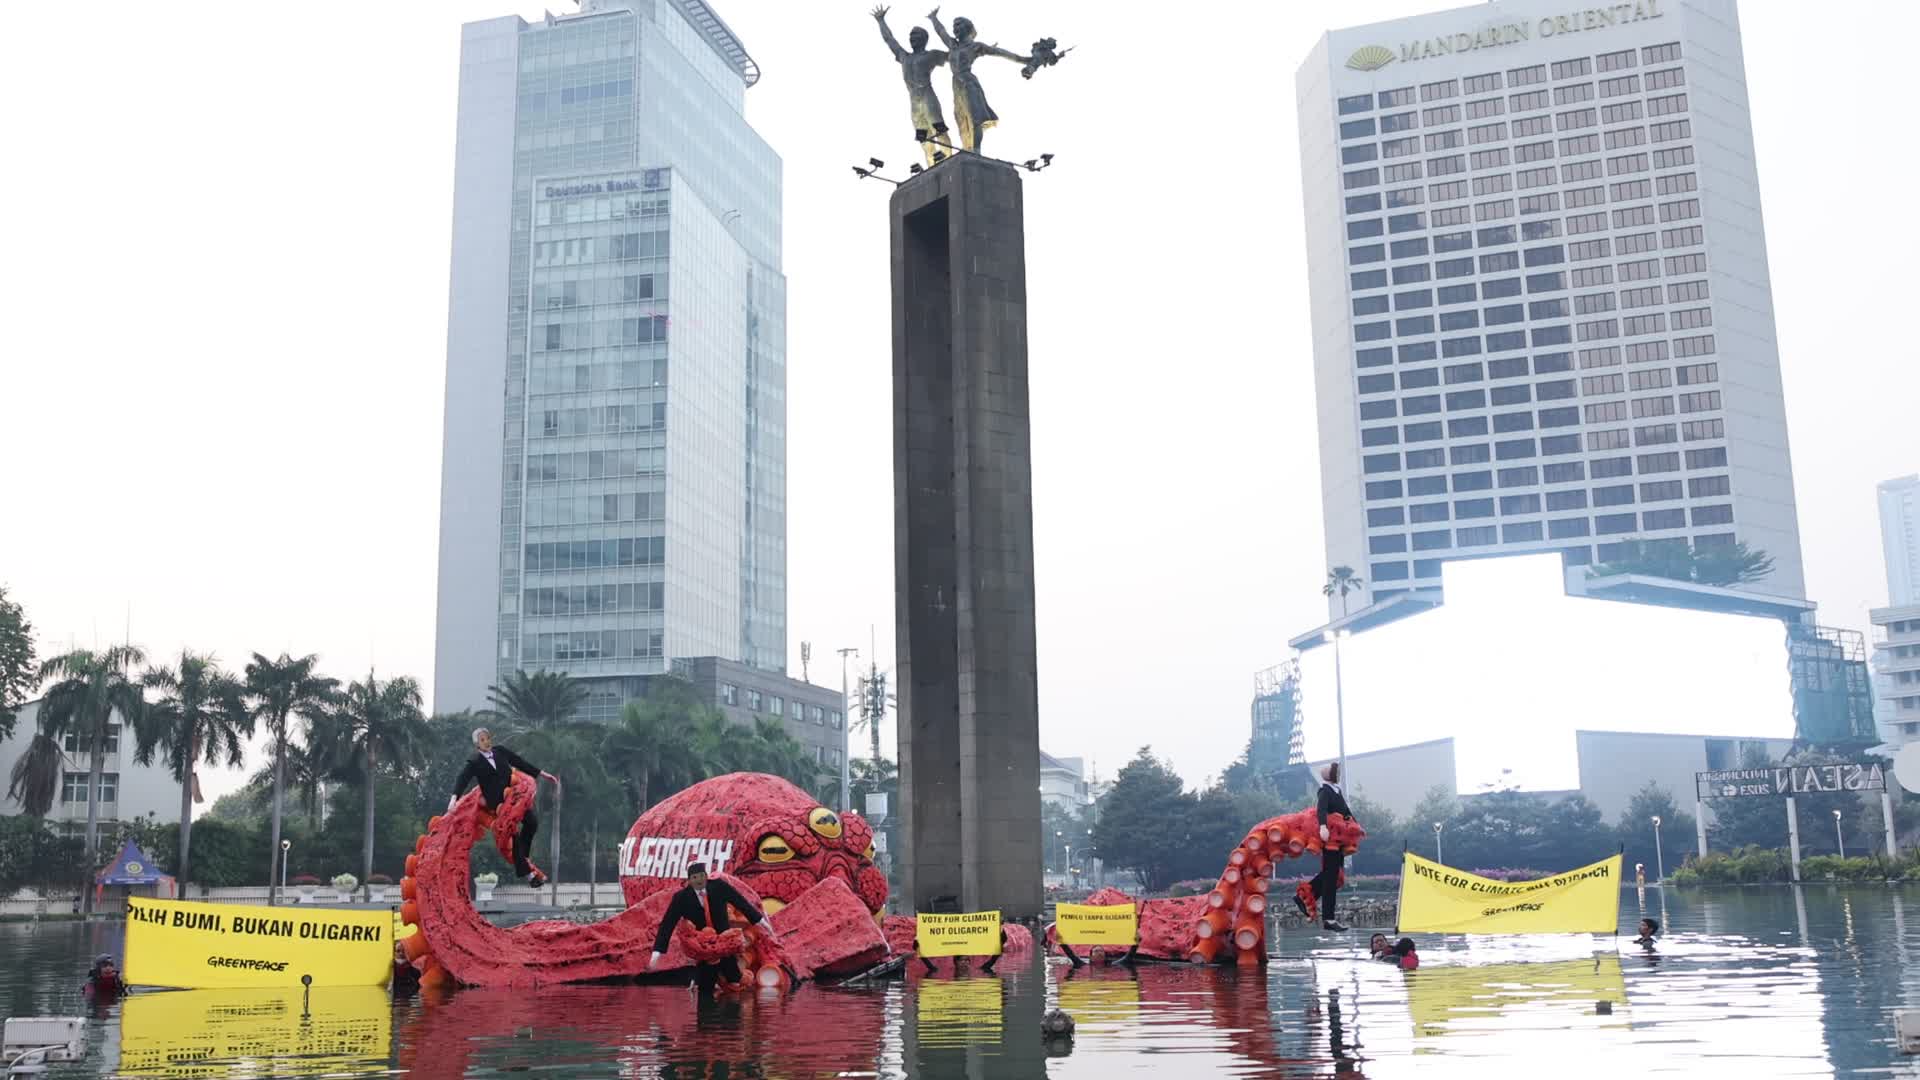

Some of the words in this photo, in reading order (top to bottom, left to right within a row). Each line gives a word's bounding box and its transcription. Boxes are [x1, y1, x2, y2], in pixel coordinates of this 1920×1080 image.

[1399, 21, 1529, 63] MANDARIN
[1538, 0, 1663, 40] ORIENTAL
[606, 179, 639, 193] Bank
[1413, 862, 1440, 882] VOTE
[1443, 873, 1469, 890] FOR
[922, 915, 943, 923] VOTE
[944, 915, 960, 923] FOR
[962, 913, 997, 922] CLIMATE
[172, 911, 227, 935] BUMI,
[232, 916, 294, 938] BUKAN
[299, 921, 381, 942] OLIGARKI
[929, 927, 945, 935] NOT
[948, 926, 989, 935] OLIGARCH
[207, 956, 289, 972] GREENPEACE
